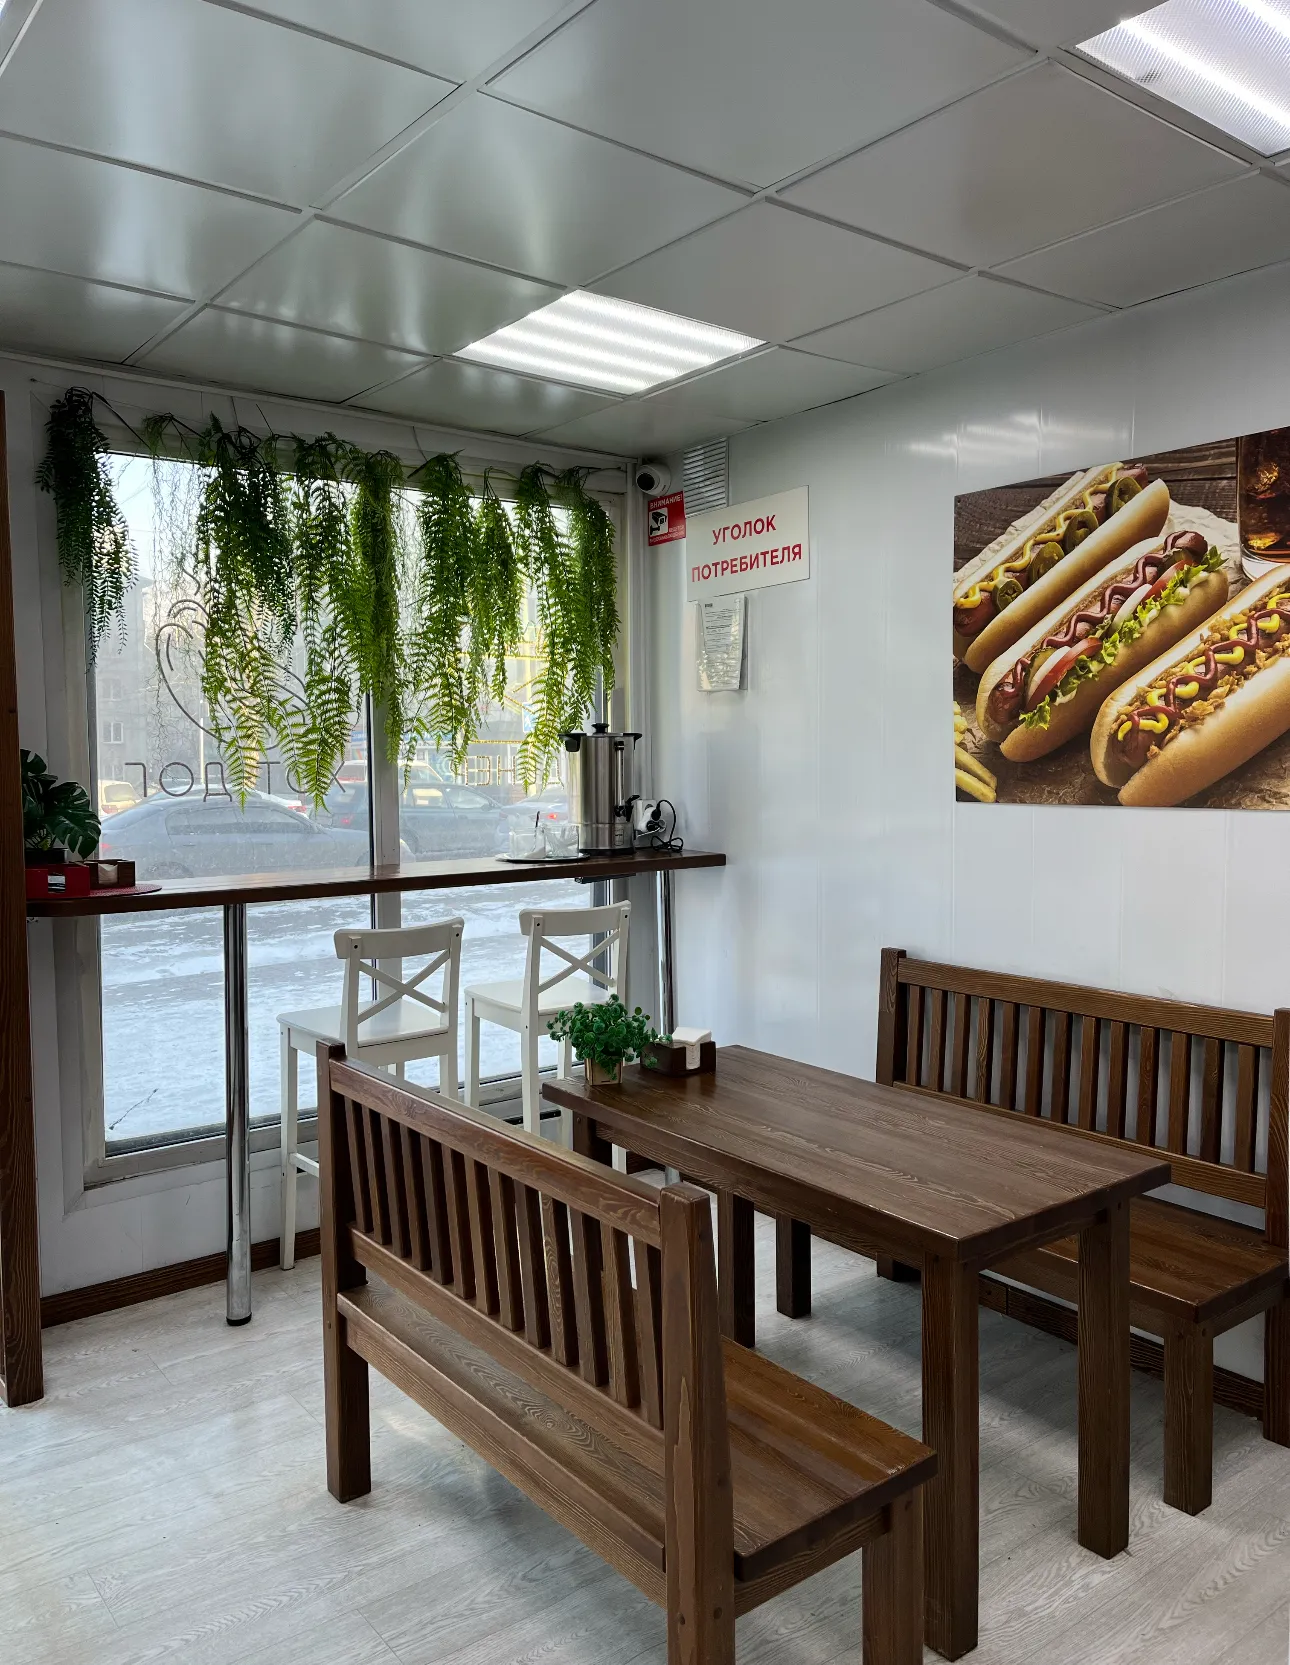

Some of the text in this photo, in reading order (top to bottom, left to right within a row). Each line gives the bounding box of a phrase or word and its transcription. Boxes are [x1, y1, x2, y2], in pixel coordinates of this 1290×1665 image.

[650, 494, 683, 509] ВНИМАНИЕ!
[712, 514, 777, 545] УГОЛОК
[691, 543, 802, 582] ПОТРЕБИТЕЛЯ
